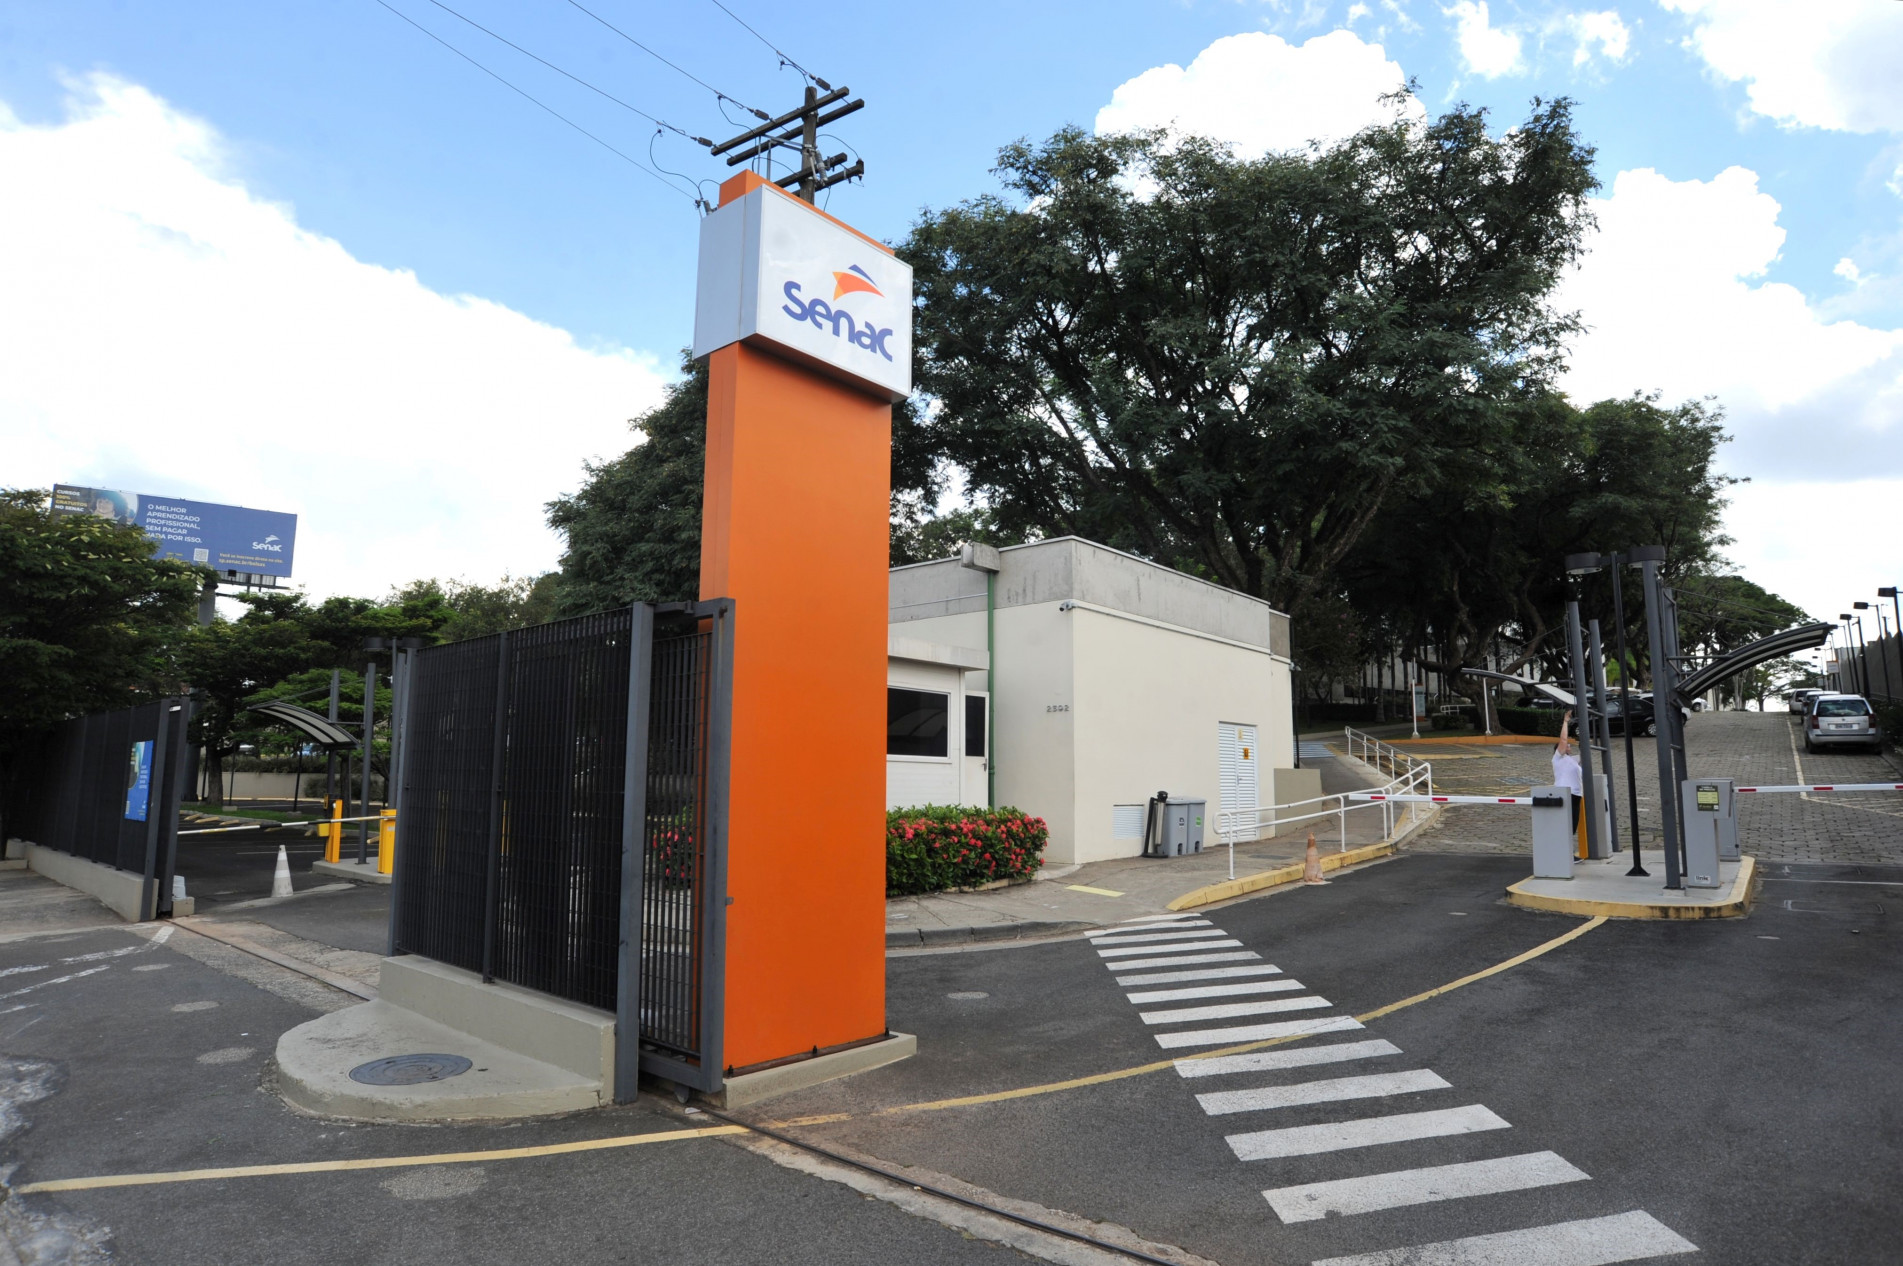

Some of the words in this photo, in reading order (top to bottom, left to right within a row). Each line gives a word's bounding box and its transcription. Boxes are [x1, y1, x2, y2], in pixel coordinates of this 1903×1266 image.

[156, 504, 187, 513] MELHOR
[146, 511, 200, 522] APRENDIZADO
[146, 518, 200, 530] PROFISSIONAL,
[162, 526, 188, 534] PAGAR
